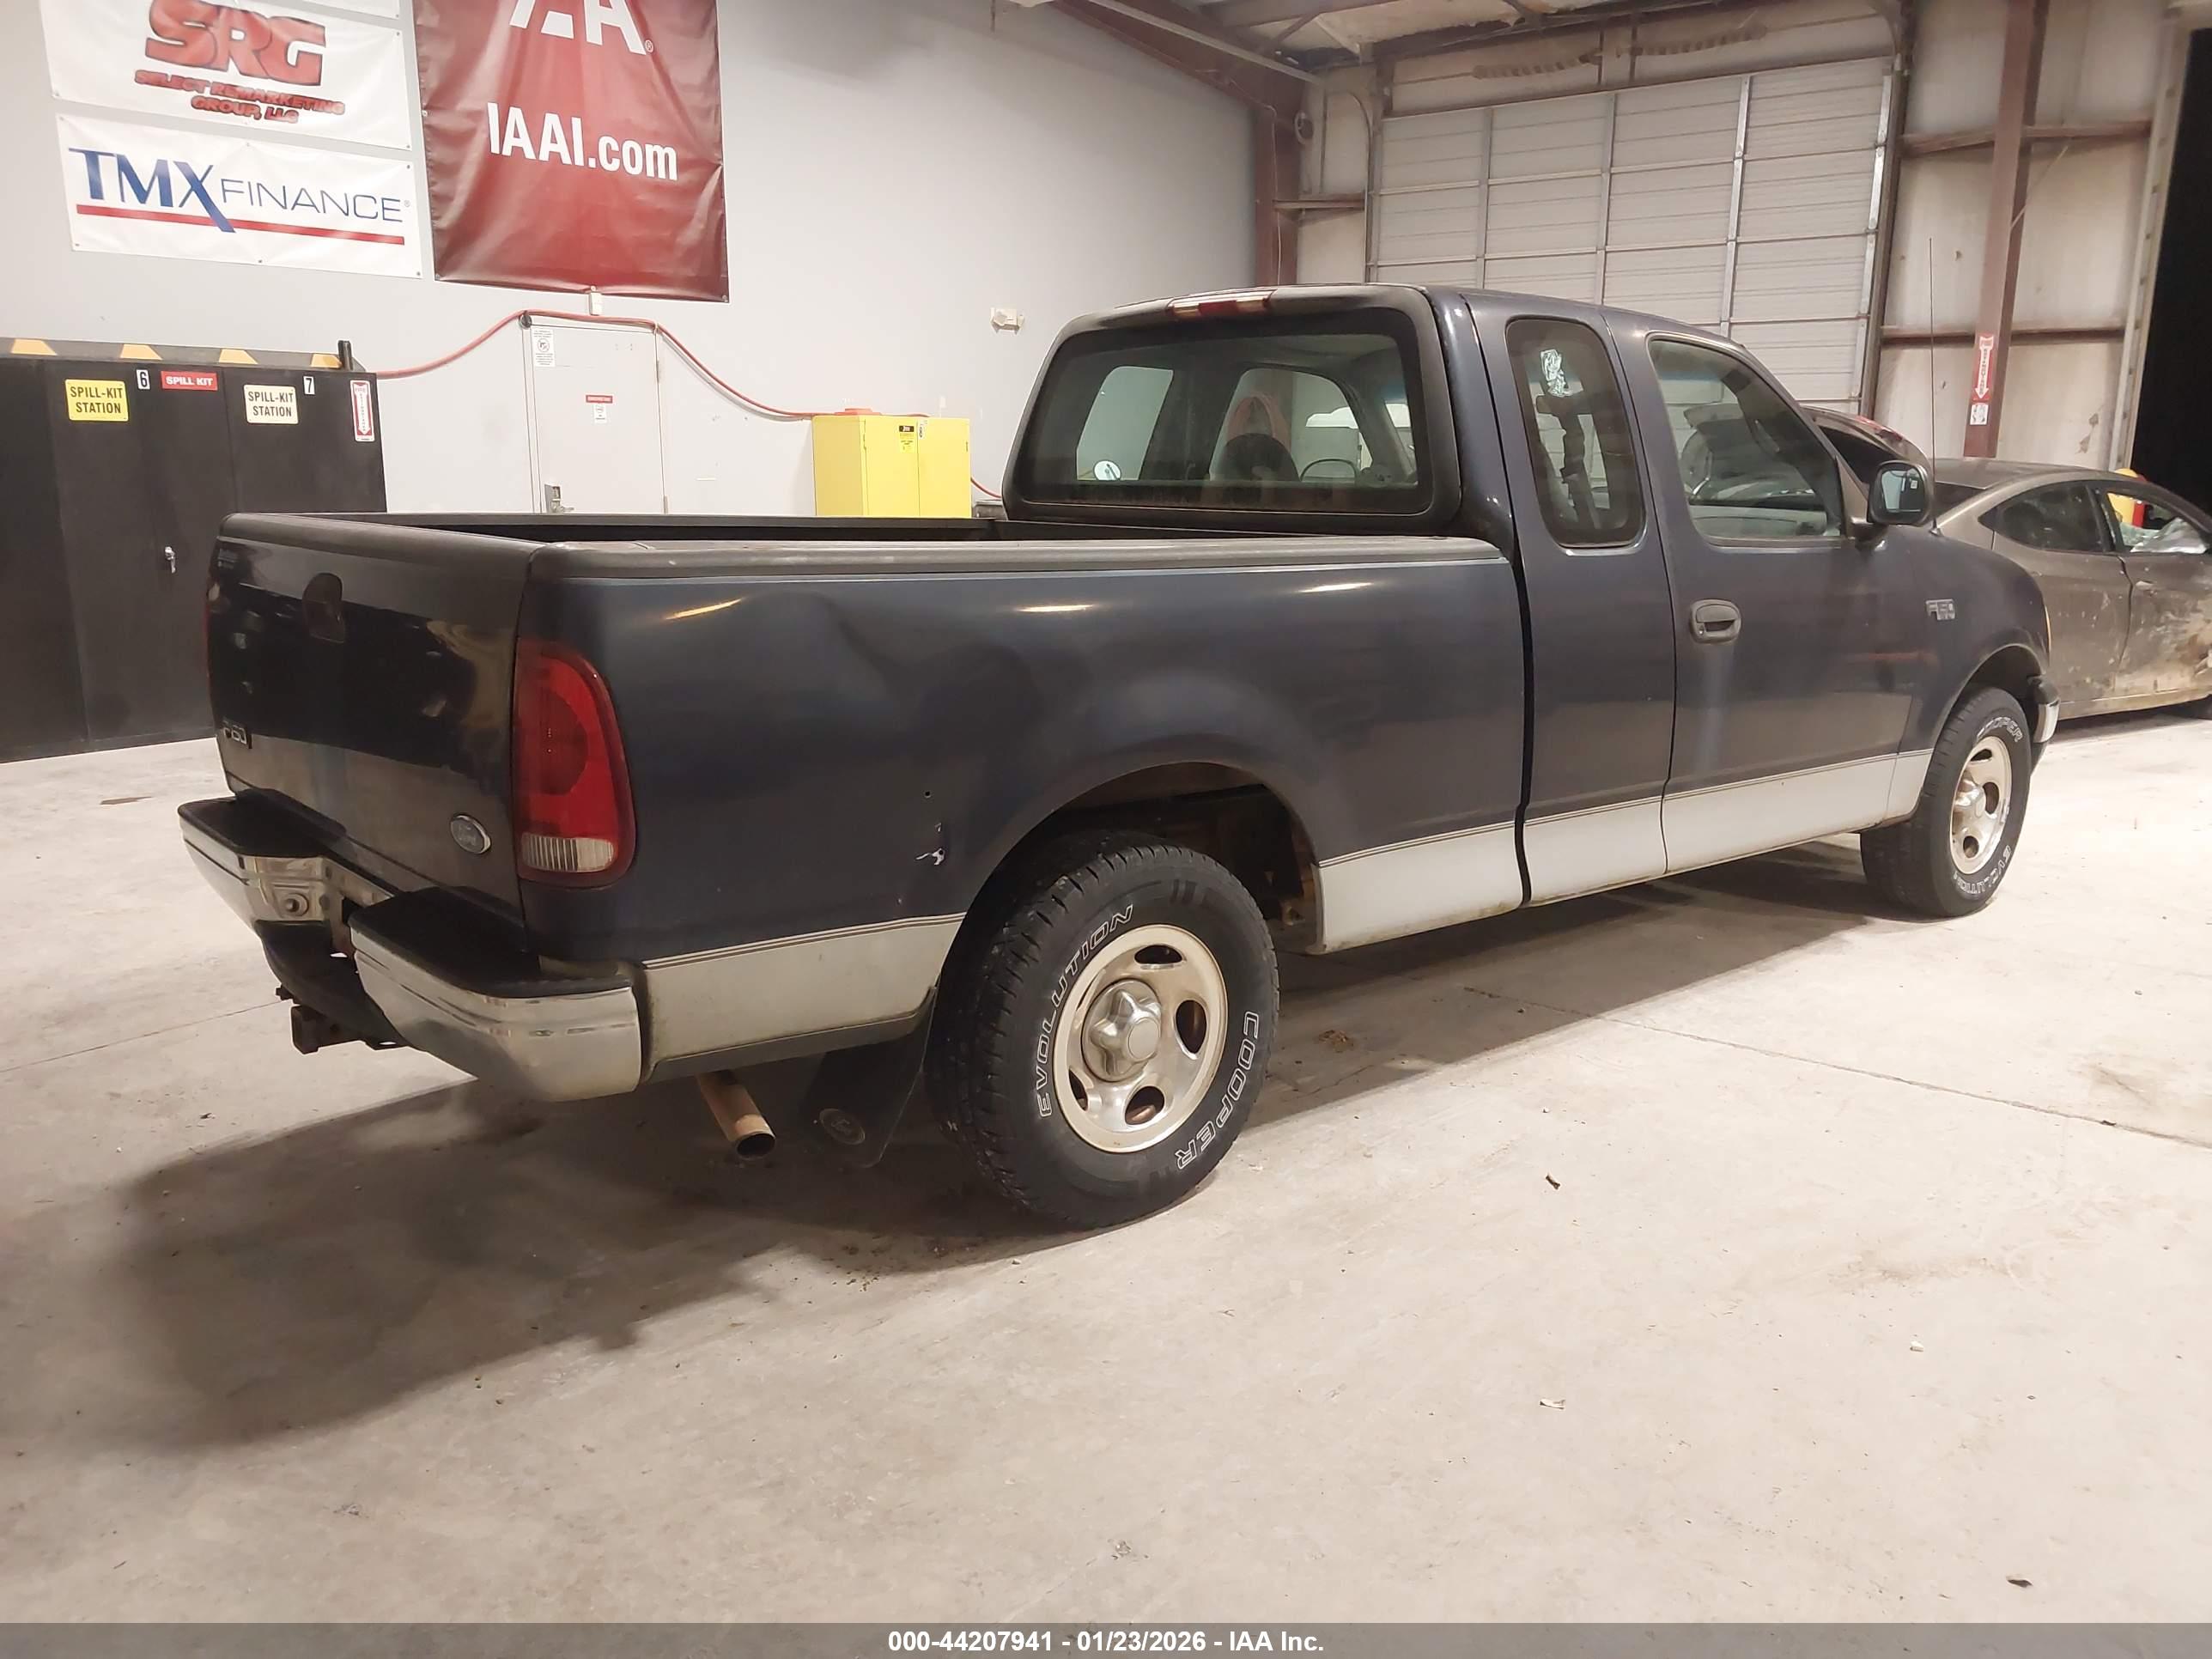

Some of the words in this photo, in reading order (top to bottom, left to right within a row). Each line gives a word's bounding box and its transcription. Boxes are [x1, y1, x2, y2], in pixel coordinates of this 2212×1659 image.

[145, 0, 325, 86] SRG
[210, 81, 345, 115] REMARKETING
[264, 106, 300, 124] LLC
[487, 102, 678, 180] IAAI.com
[140, 372, 148, 387] 6
[166, 375, 195, 386] SPILL
[196, 377, 214, 386] KIT
[306, 378, 312, 393] 7
[70, 386, 123, 399] SPILL-KIT
[248, 391, 294, 403] SPILL-KIT
[76, 402, 121, 414] STATION
[252, 405, 292, 417] STATION
[1036, 904, 1133, 1117] EVOLUTION
[1175, 1011, 1260, 1170] COOPER
